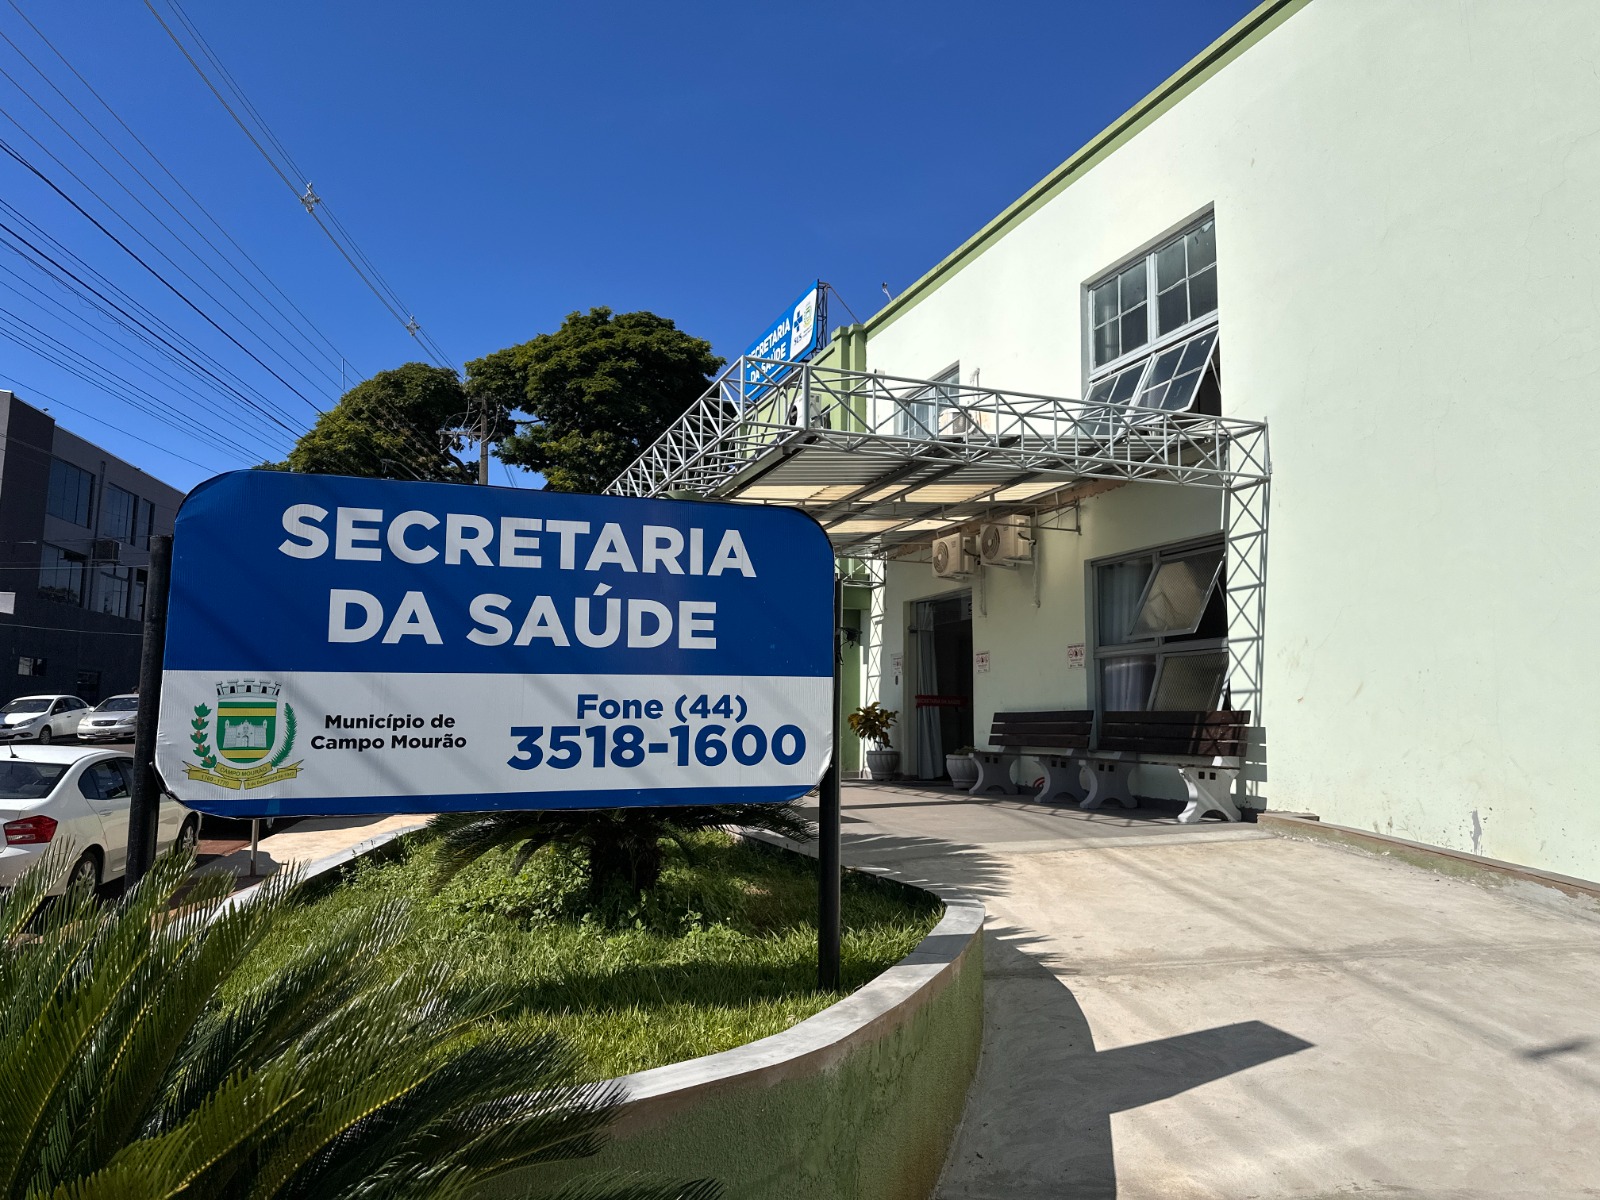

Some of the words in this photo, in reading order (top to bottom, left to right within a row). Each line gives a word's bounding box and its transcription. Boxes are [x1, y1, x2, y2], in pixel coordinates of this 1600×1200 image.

[279, 503, 756, 578] SECRETARIA
[328, 588, 444, 646] DA
[466, 582, 718, 650] SAÚDE
[325, 714, 425, 731] Município
[430, 714, 456, 728] de
[576, 694, 664, 720] Fone
[674, 694, 748, 723] (44)
[310, 735, 385, 752] Campo
[391, 733, 467, 749] Mourão
[507, 724, 806, 771] 3518-1600
[220, 767, 241, 777] CAMPO
[241, 766, 268, 777] MOURÃO
